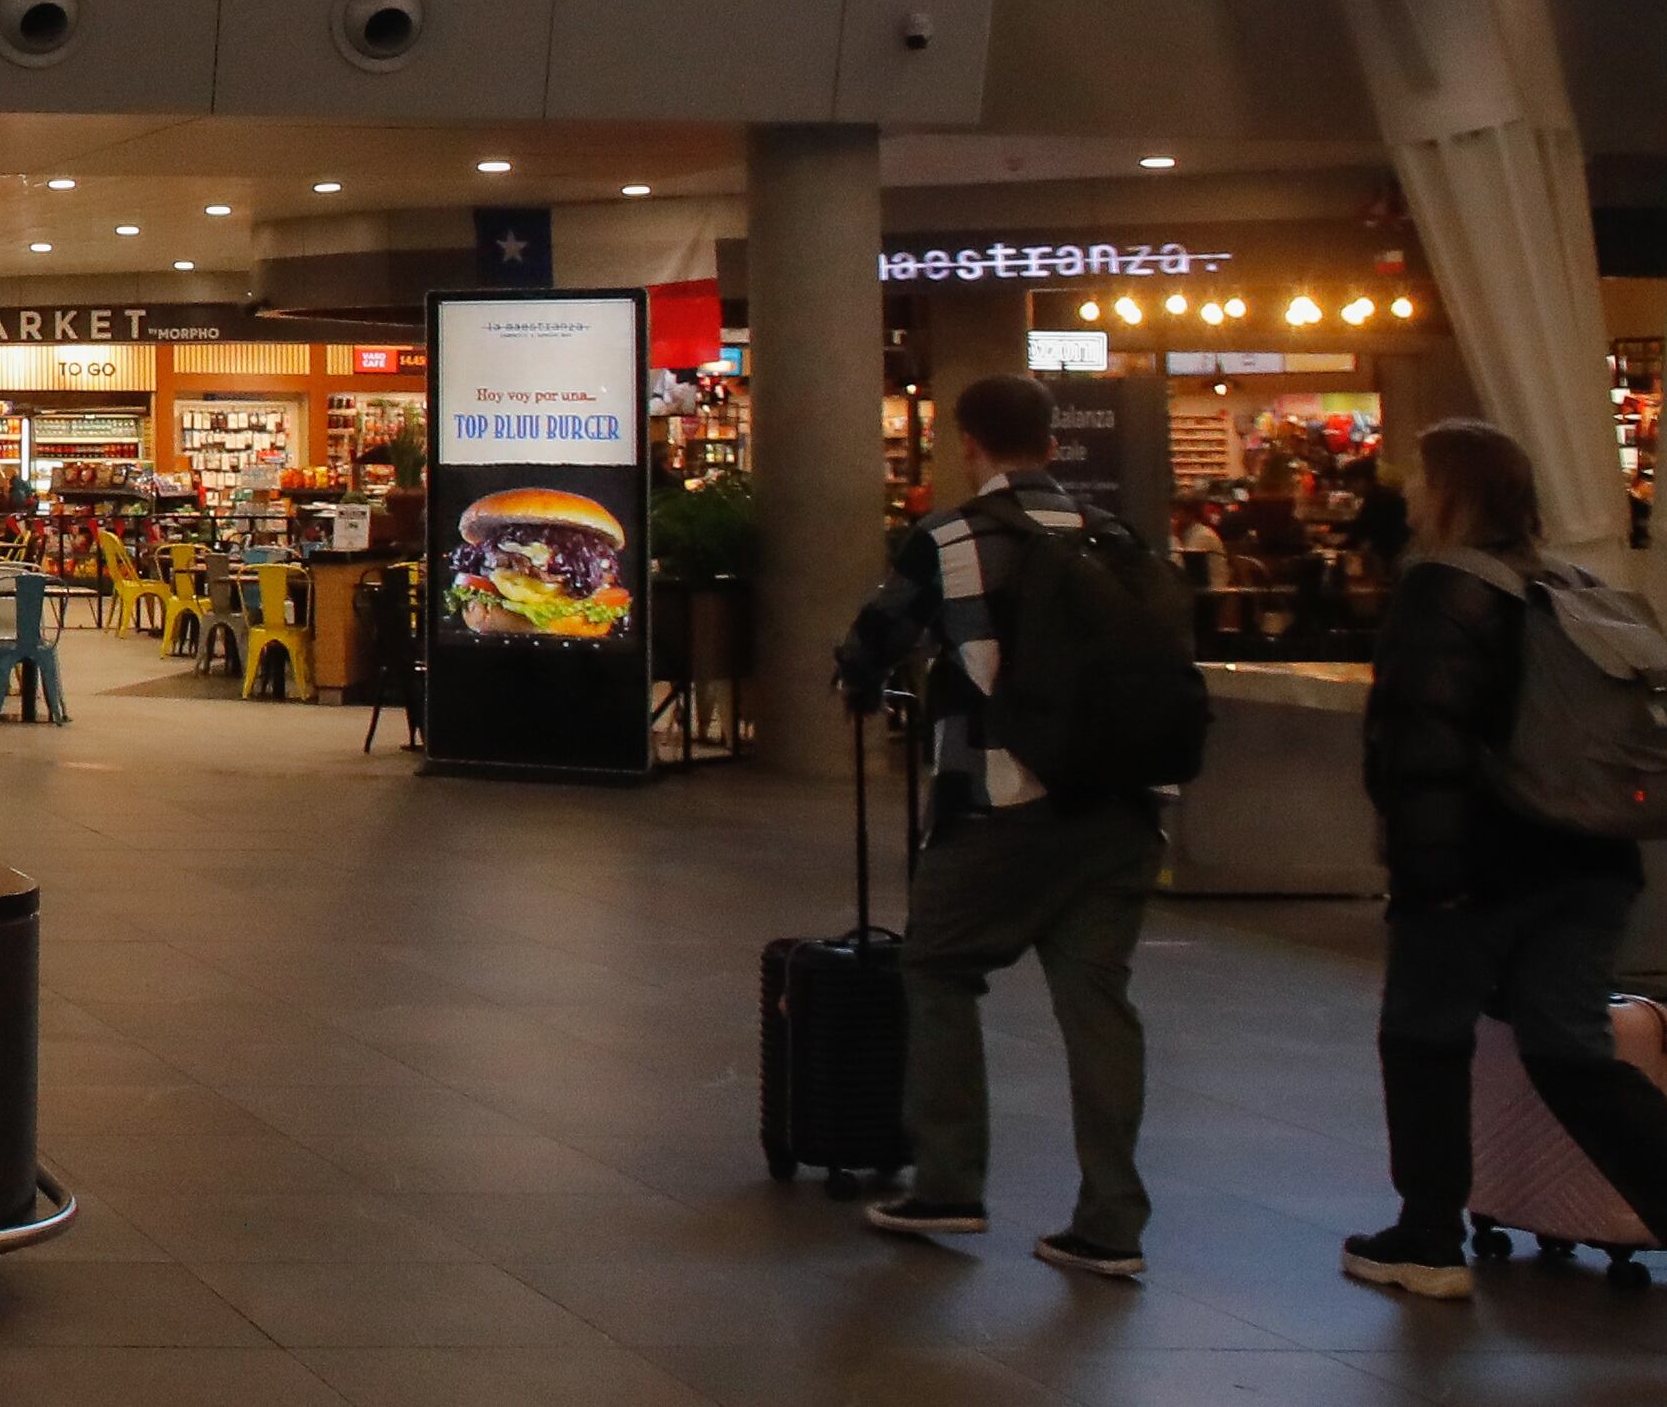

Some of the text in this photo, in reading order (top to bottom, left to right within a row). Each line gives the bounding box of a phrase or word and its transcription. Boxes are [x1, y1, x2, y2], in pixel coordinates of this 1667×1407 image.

[878, 242, 1222, 282] aestranza.
[158, 327, 220, 341] MORPHO
[58, 363, 82, 376] TO
[87, 363, 116, 376] GO
[476, 388, 502, 403] Hoy
[509, 390, 530, 403] voy
[535, 391, 558, 404] por
[454, 413, 489, 440] TOP
[545, 414, 620, 441] BURGER
